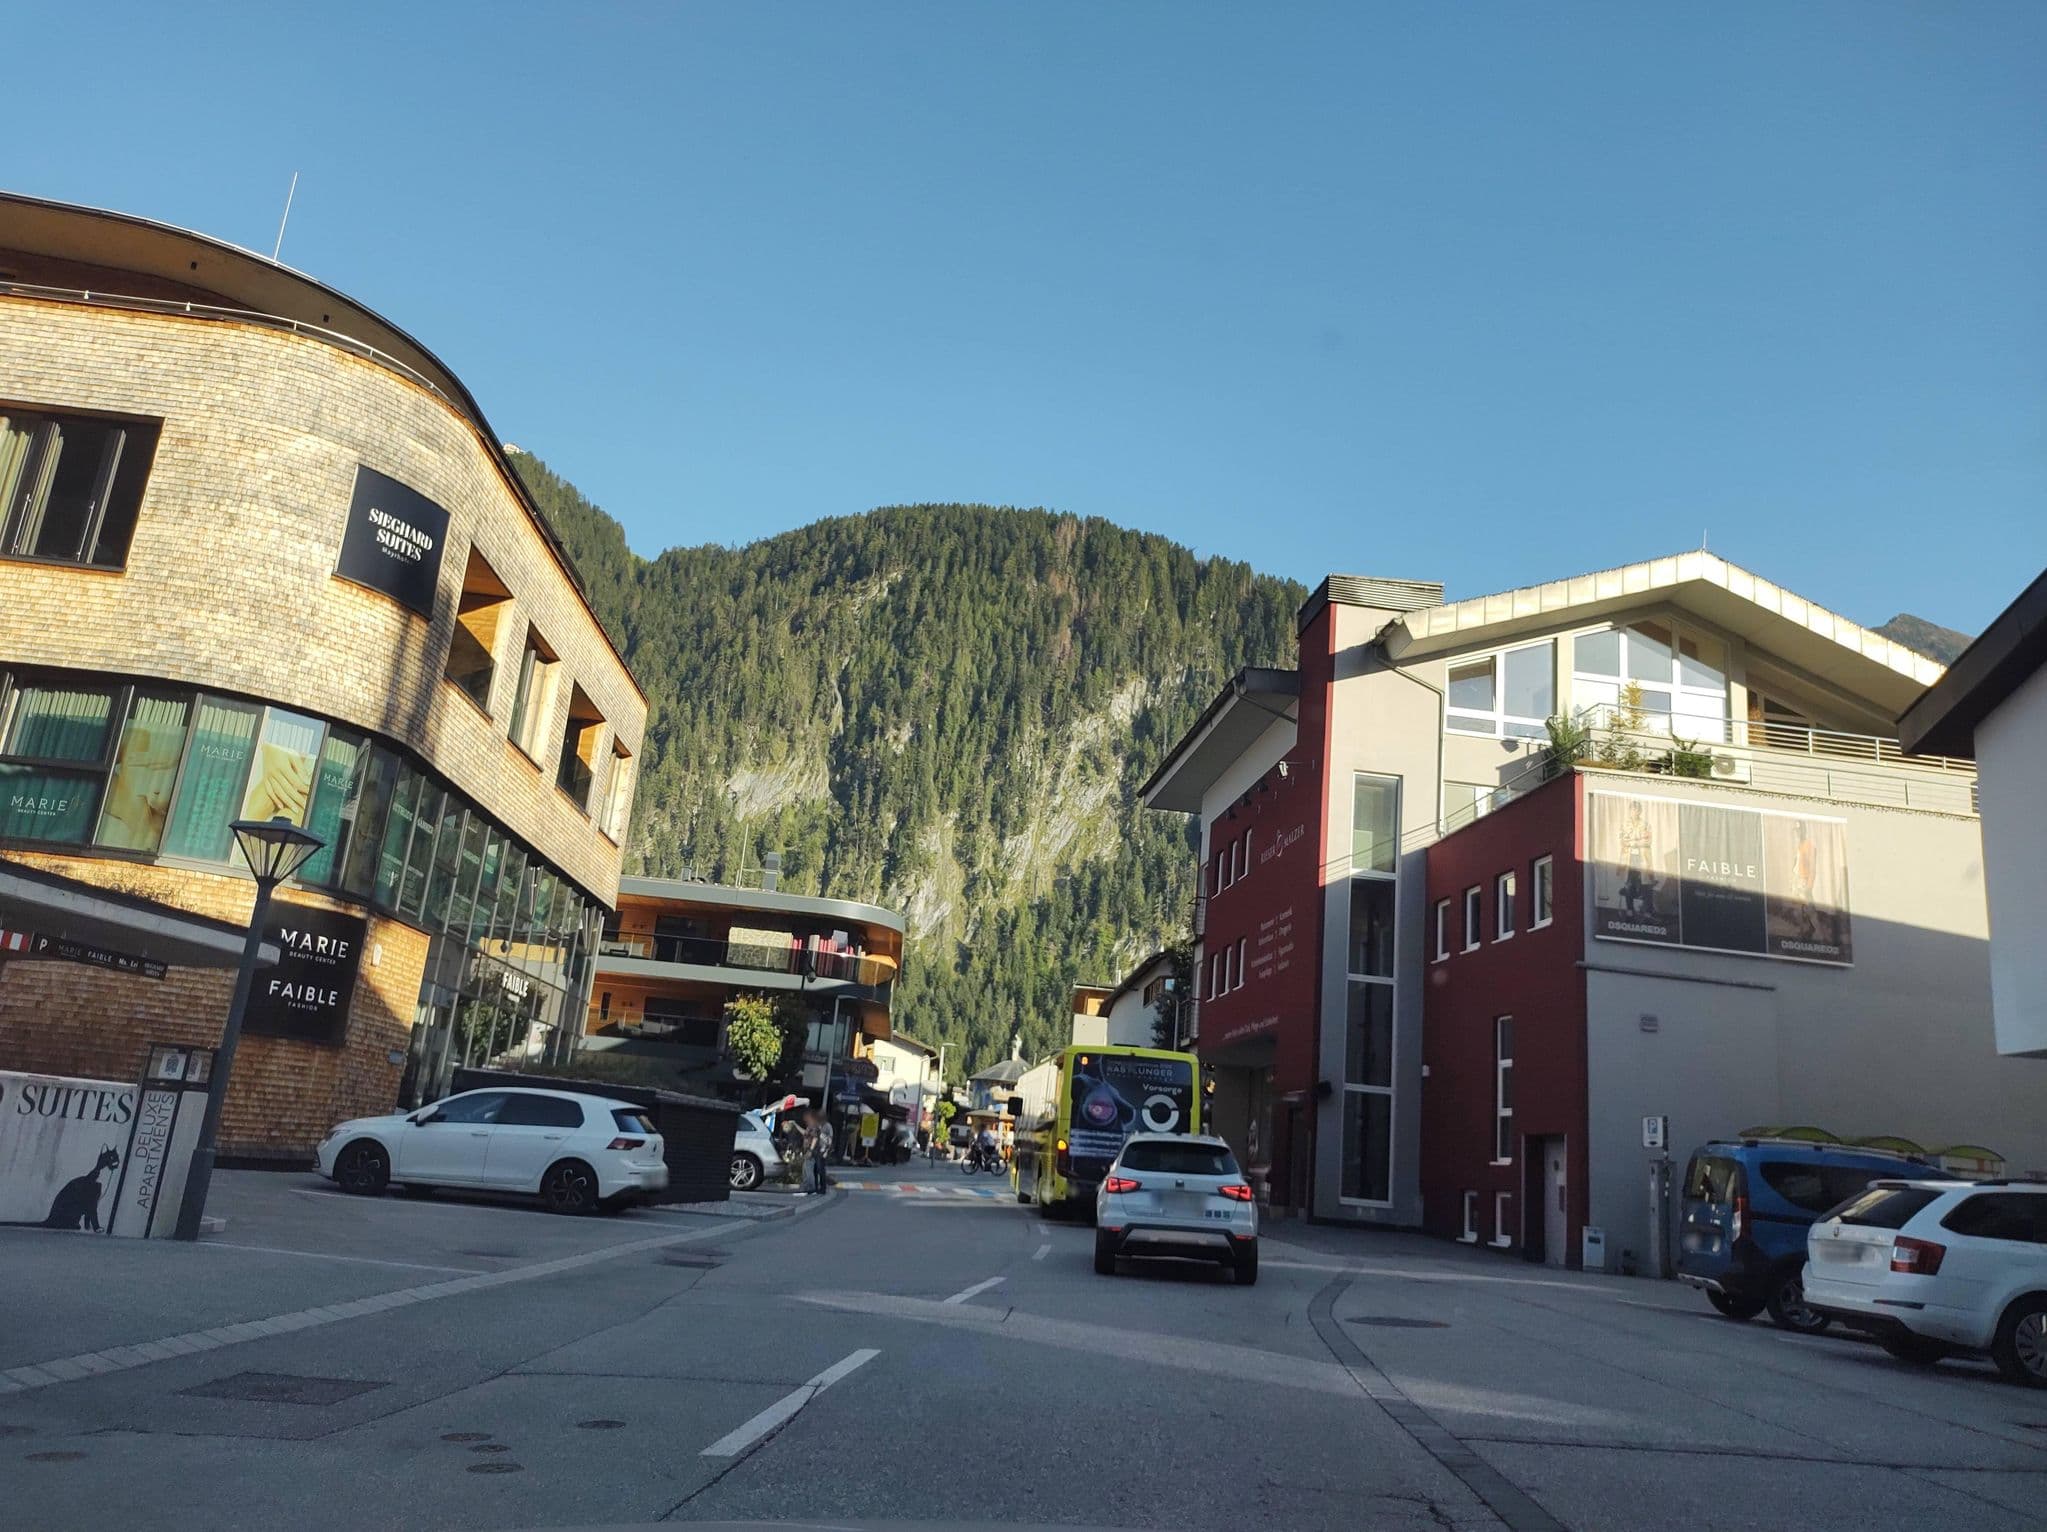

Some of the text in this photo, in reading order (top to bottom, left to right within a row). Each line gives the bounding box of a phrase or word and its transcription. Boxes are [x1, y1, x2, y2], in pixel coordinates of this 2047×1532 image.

[368, 507, 433, 551] SIEGHARD
[376, 528, 422, 562] SUITES
[381, 546, 413, 566] Mayrho
[200, 744, 244, 760] MARIE
[323, 773, 354, 789] MARIE
[11, 795, 68, 812] MARIE
[1687, 858, 1756, 879] FAIBLE
[1607, 920, 1667, 936] DSQUARED2
[39, 938, 49, 951] P
[281, 928, 349, 958] MARIE
[1780, 939, 1840, 955] DSQUARED2
[289, 950, 336, 965] BEAUTY CENTER
[269, 979, 338, 1006] FAIBLE
[502, 971, 529, 998] FAIBLE
[288, 1001, 318, 1012] FASHION
[1142, 1083, 1183, 1096] Vorsorge
[17, 1084, 133, 1125] SUITES
[135, 1094, 163, 1159] DELUXE
[137, 1094, 175, 1210] APARTMENTS
